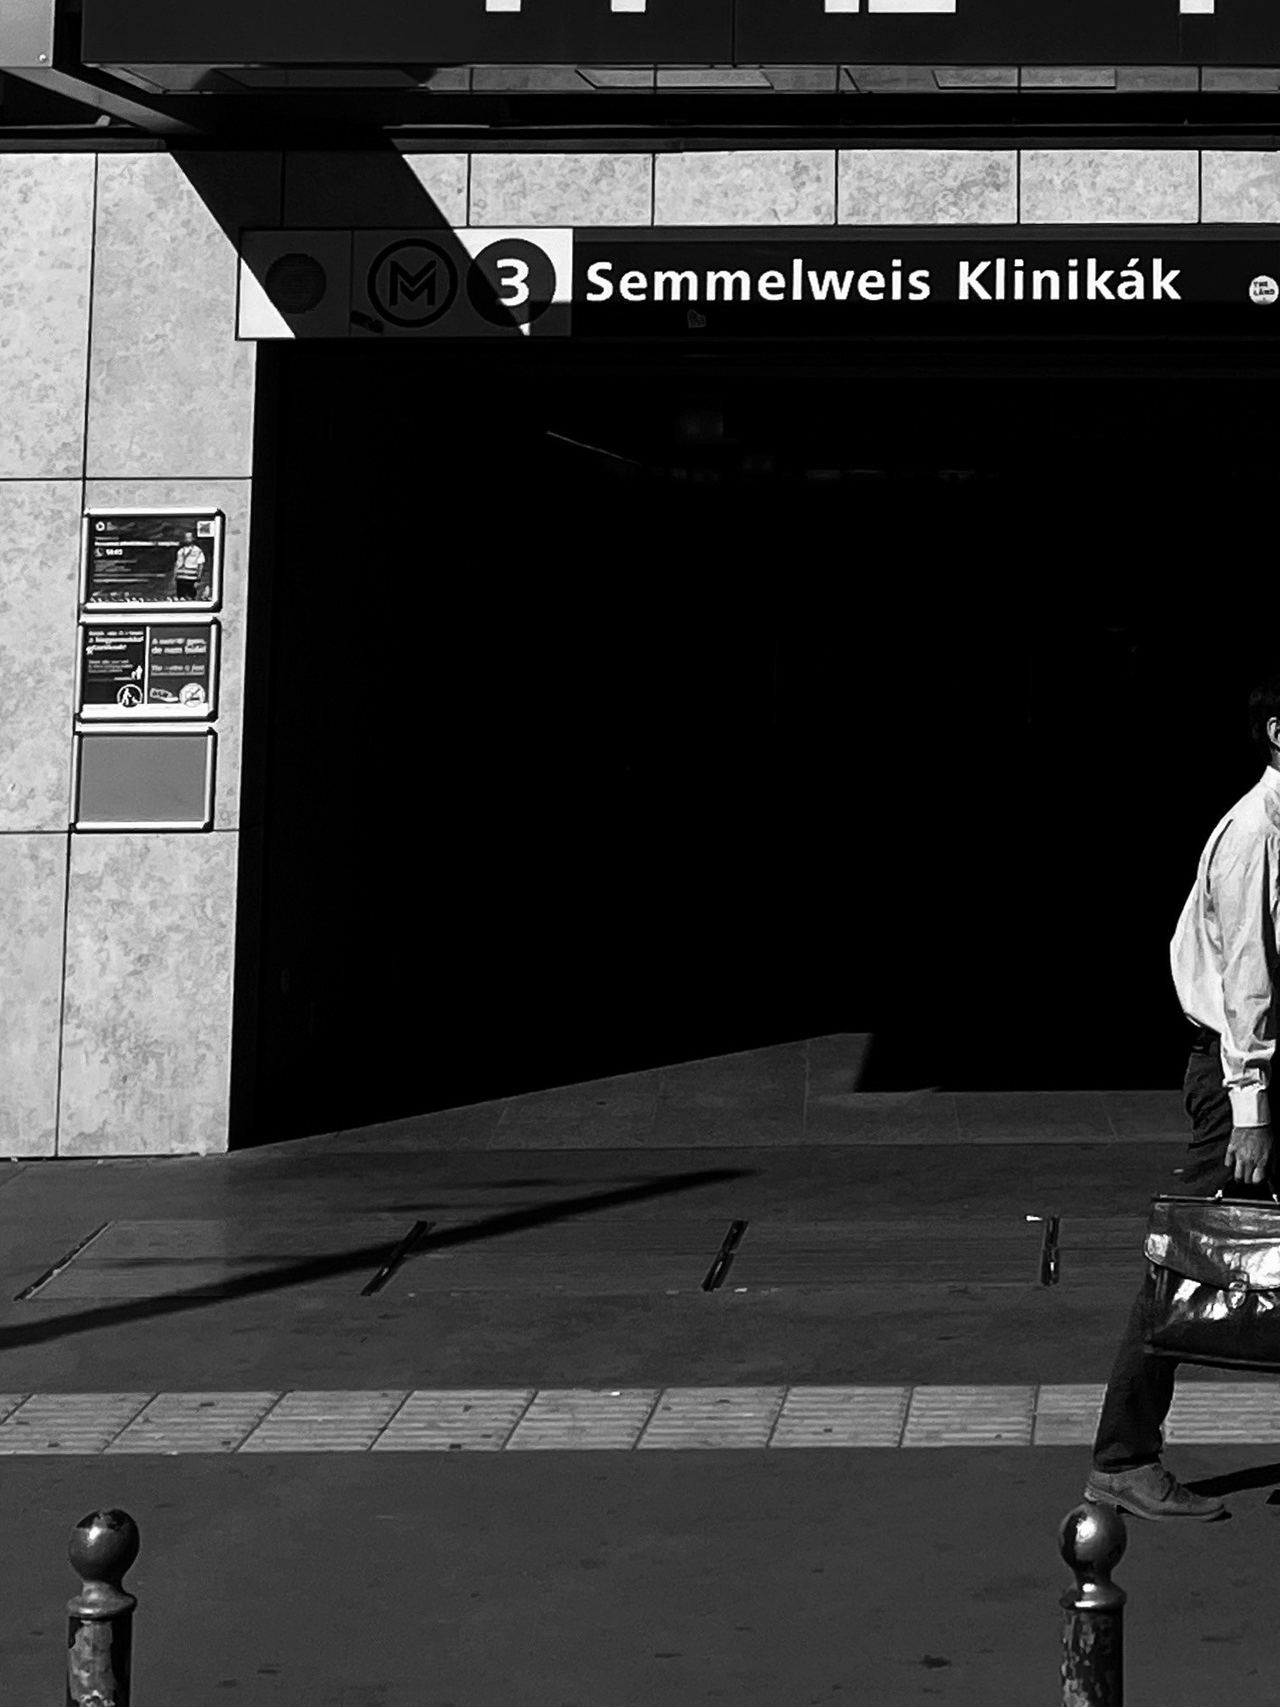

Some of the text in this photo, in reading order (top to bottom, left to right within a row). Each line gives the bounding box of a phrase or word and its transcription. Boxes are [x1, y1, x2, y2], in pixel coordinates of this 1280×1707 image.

[497, 258, 529, 307] 3
[586, 258, 931, 302] Semmelweis
[958, 257, 1182, 301] Klinikák
